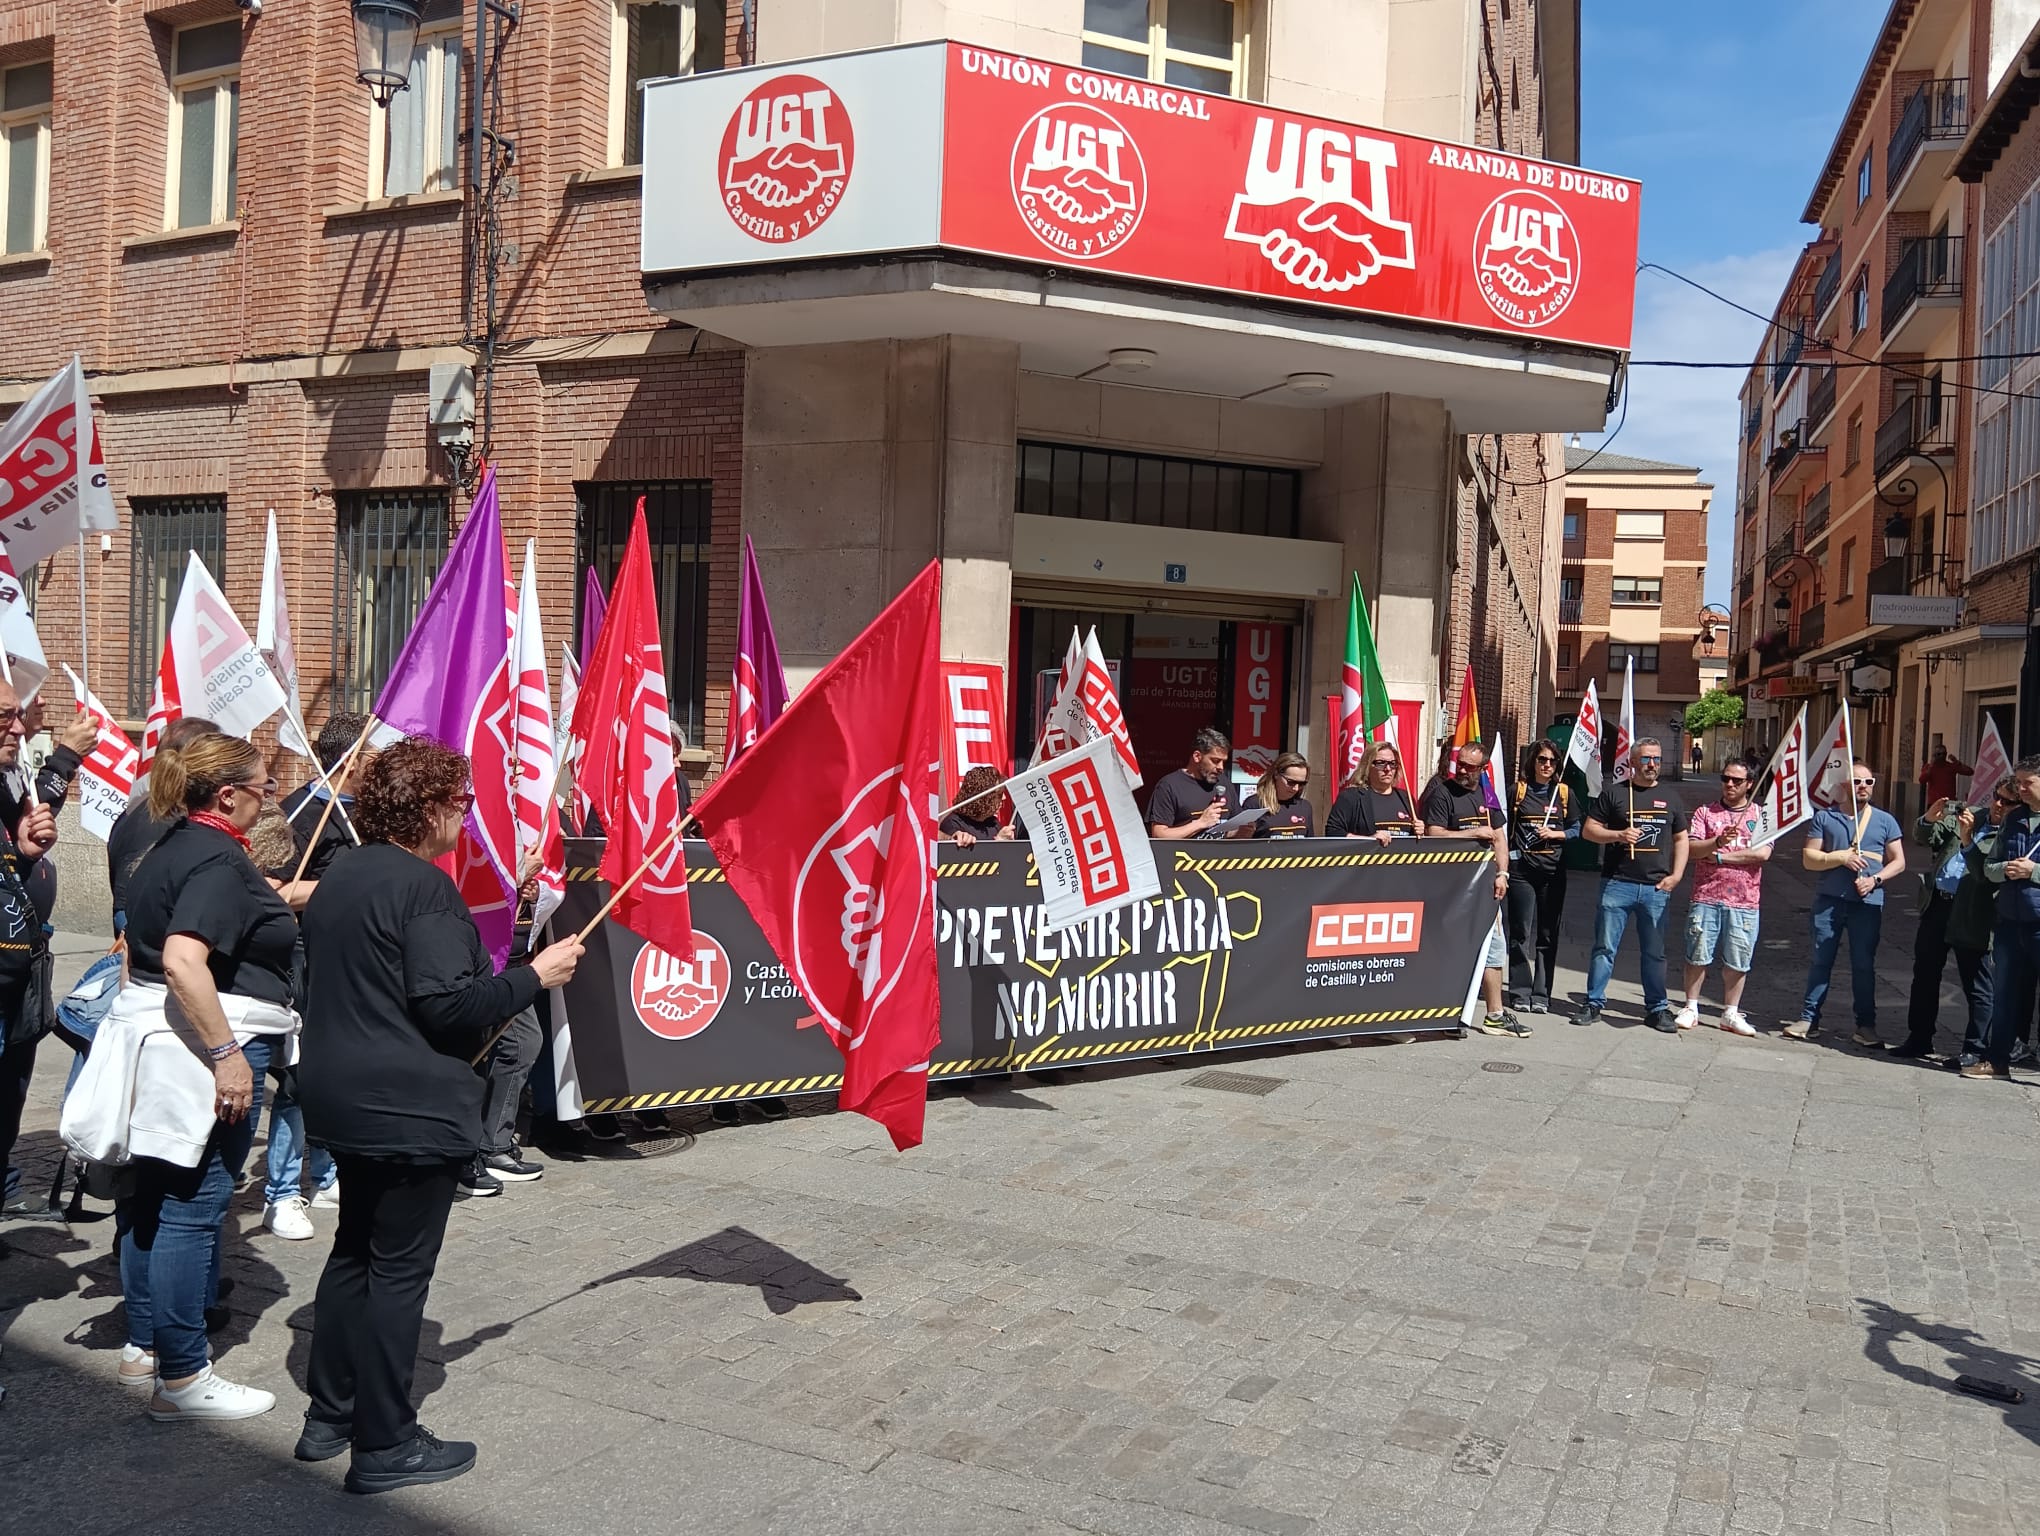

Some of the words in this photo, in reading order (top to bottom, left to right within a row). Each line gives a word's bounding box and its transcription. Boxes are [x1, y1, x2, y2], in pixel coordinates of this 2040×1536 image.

[960, 48, 1052, 90] UNIÓN
[1064, 71, 1211, 122] COMARCAL
[734, 88, 834, 160] UGT
[1031, 115, 1126, 183] UGT
[1245, 115, 1399, 222] UGT
[1427, 143, 1522, 183] ARANDA
[1525, 165, 1555, 189] DE
[1558, 171, 1630, 204] DUERO
[725, 189, 785, 241] Castilla
[789, 219, 802, 241] y
[803, 176, 845, 230] León
[1020, 192, 1079, 252] Castilla
[1081, 237, 1096, 256] y
[1096, 208, 1136, 250] León
[1490, 201, 1566, 258] UGT
[1479, 270, 1525, 322] Castilla
[1527, 307, 1538, 324] y
[1539, 283, 1572, 319] León
[1172, 567, 1180, 580] 8
[1151, 687, 1164, 697] de
[1162, 665, 1207, 686] UGT
[1247, 628, 1272, 738] UGT
[1025, 781, 1038, 799] de
[1034, 800, 1057, 845] Castilla
[1036, 776, 1070, 846] comisiones
[1064, 848, 1080, 894] obreras
[1048, 844, 1059, 855] y
[1060, 769, 1119, 895] CCOO
[1053, 855, 1067, 887] León
[1131, 896, 1234, 955] PARA
[1315, 912, 1415, 947] CCOO
[643, 948, 718, 992] UGT
[1305, 975, 1318, 988] de
[1320, 972, 1358, 987] Castilla
[1359, 973, 1367, 987] y
[1368, 970, 1395, 983] León
[1306, 958, 1364, 973] comisiones
[1366, 956, 1406, 969] obreras
[743, 985, 756, 1005] y
[994, 979, 1047, 1041] NO
[1057, 968, 1178, 1035] MORIR
